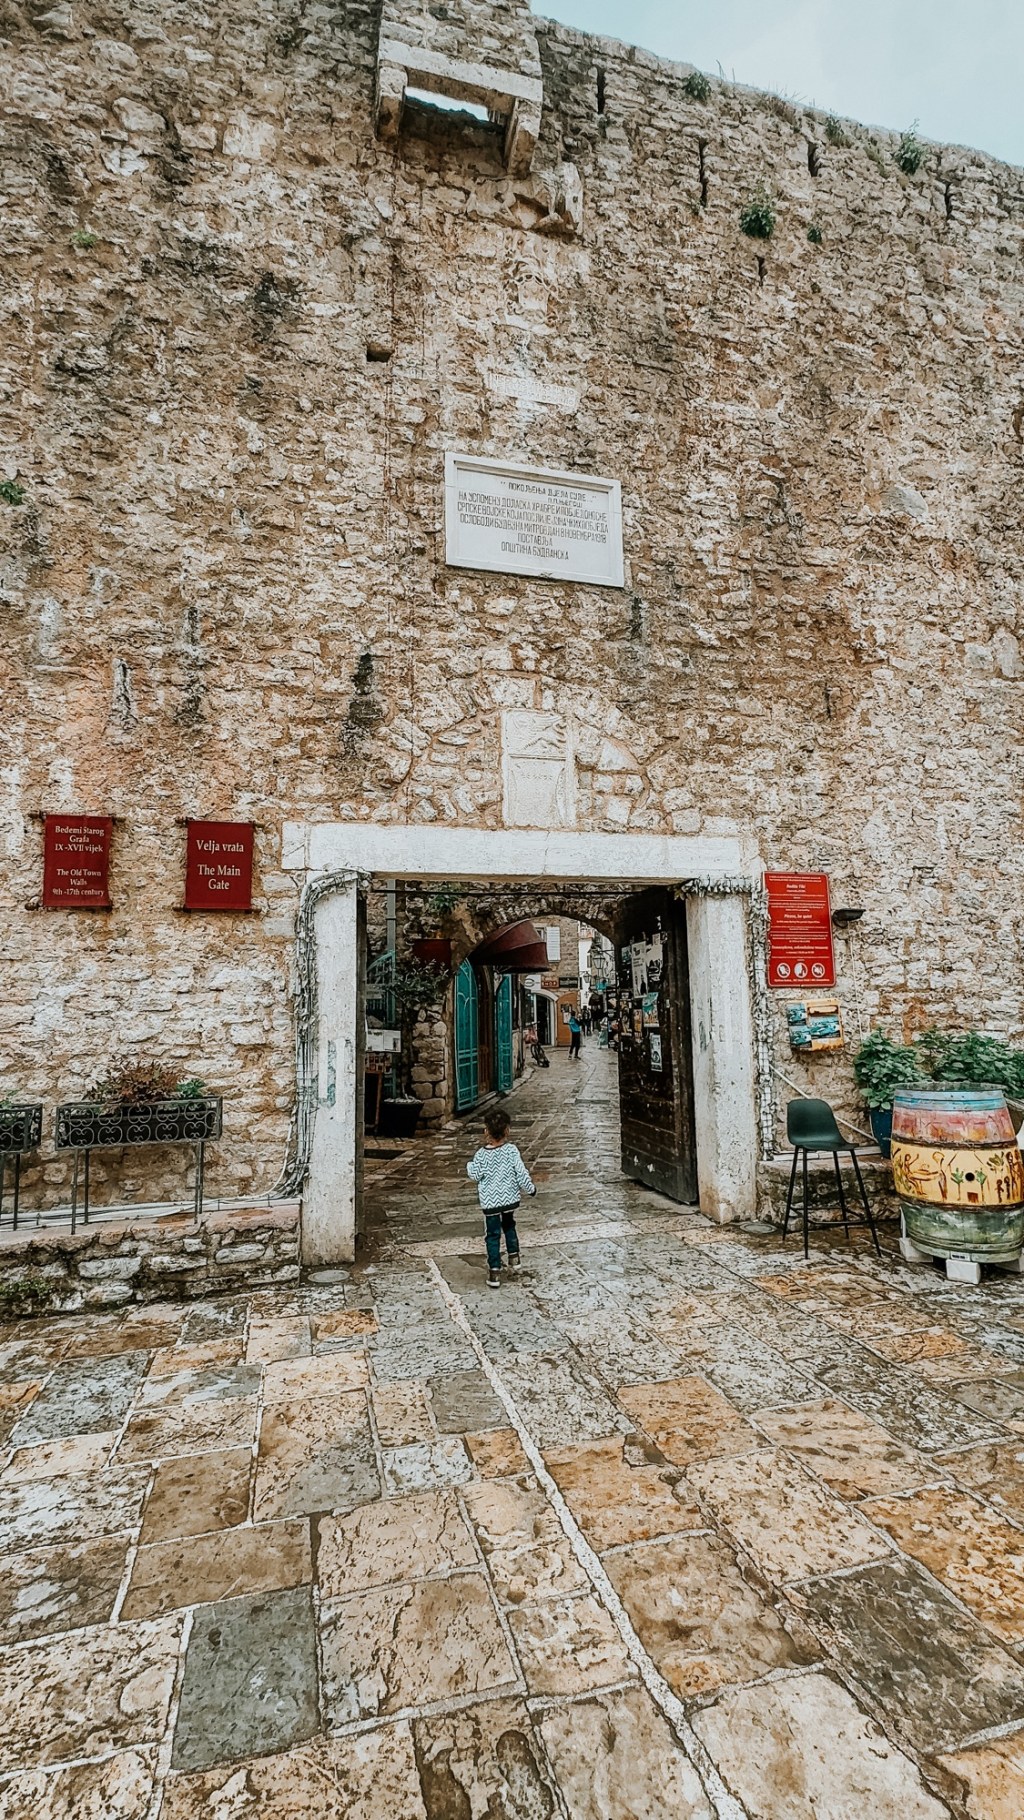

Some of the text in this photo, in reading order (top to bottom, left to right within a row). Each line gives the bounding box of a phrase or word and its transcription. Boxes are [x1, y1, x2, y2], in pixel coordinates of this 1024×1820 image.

[458, 490, 467, 502] НА
[457, 501, 482, 515] СРПСКЕ
[517, 532, 554, 547] ПОСТАВЉА
[501, 541, 532, 555] ОПШТИНА
[55, 825, 105, 837] Bedemi Starog
[85, 844, 104, 855] vijek
[196, 839, 245, 855] Velja vrata
[56, 868, 102, 877] The Old Town
[197, 864, 241, 876] The Main
[70, 878, 88, 886] Walls
[208, 878, 230, 890] Gate
[81, 888, 104, 898] century
